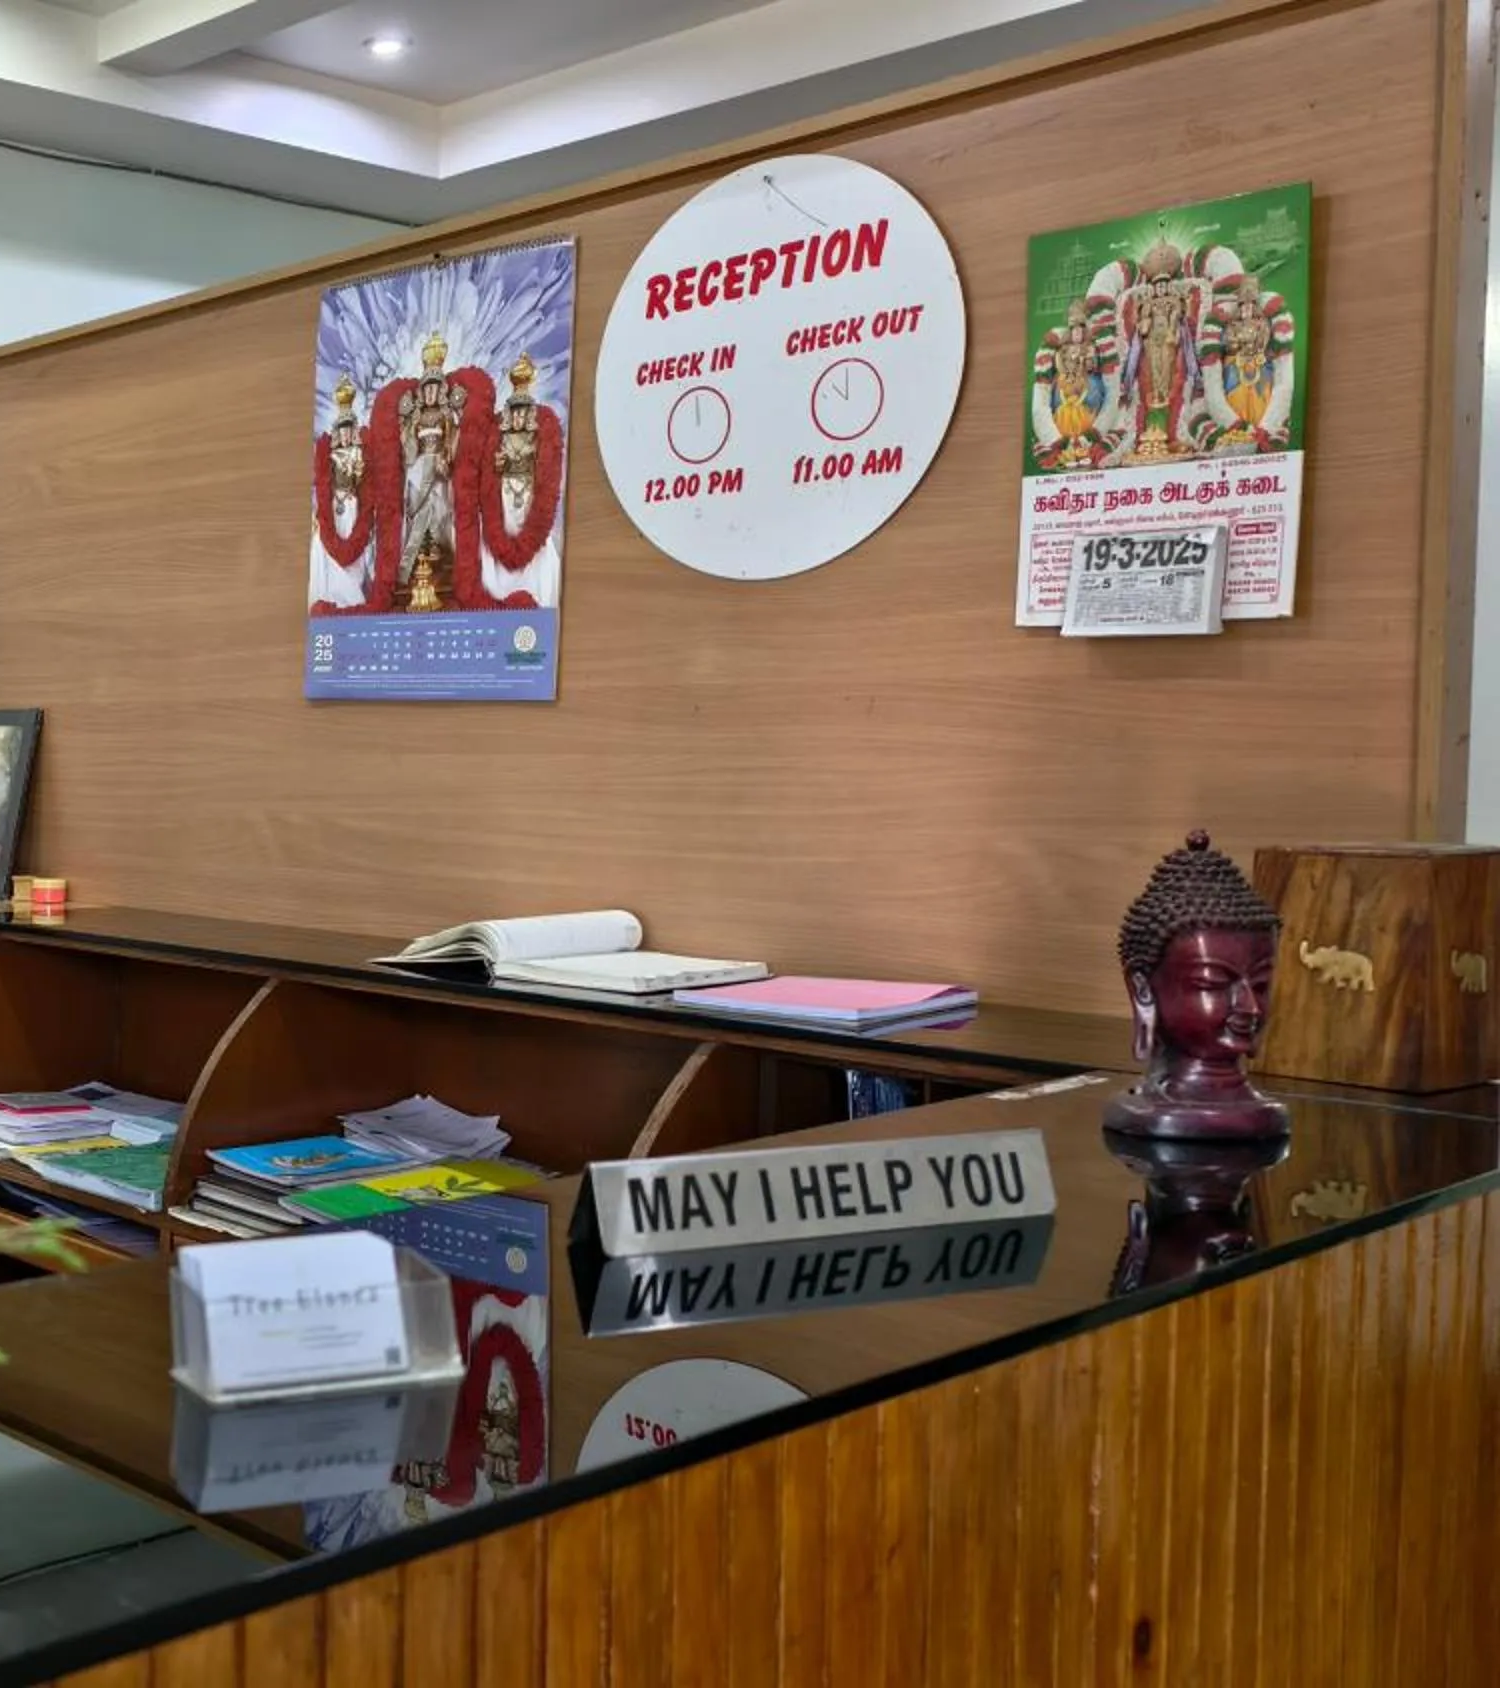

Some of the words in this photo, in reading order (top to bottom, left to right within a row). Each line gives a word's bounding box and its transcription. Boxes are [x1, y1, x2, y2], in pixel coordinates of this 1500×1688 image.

[645, 218, 889, 322] RECEPTION
[785, 315, 867, 357] CHECK
[871, 304, 925, 337] OUT
[636, 351, 705, 388] CHECK
[710, 344, 737, 372] IN
[644, 474, 700, 503] 12.00
[707, 467, 744, 494] PM
[792, 452, 855, 485] 11.00
[861, 446, 904, 475] AM
[1033, 487, 1099, 515] கவிதா
[1103, 487, 1153, 513] நகை
[1236, 475, 1287, 497] கடை
[315, 635, 333, 647] 20
[628, 1171, 738, 1234] MAY
[759, 1169, 776, 1223] I
[790, 1159, 912, 1221] HELP
[929, 1151, 1025, 1209] YOU
